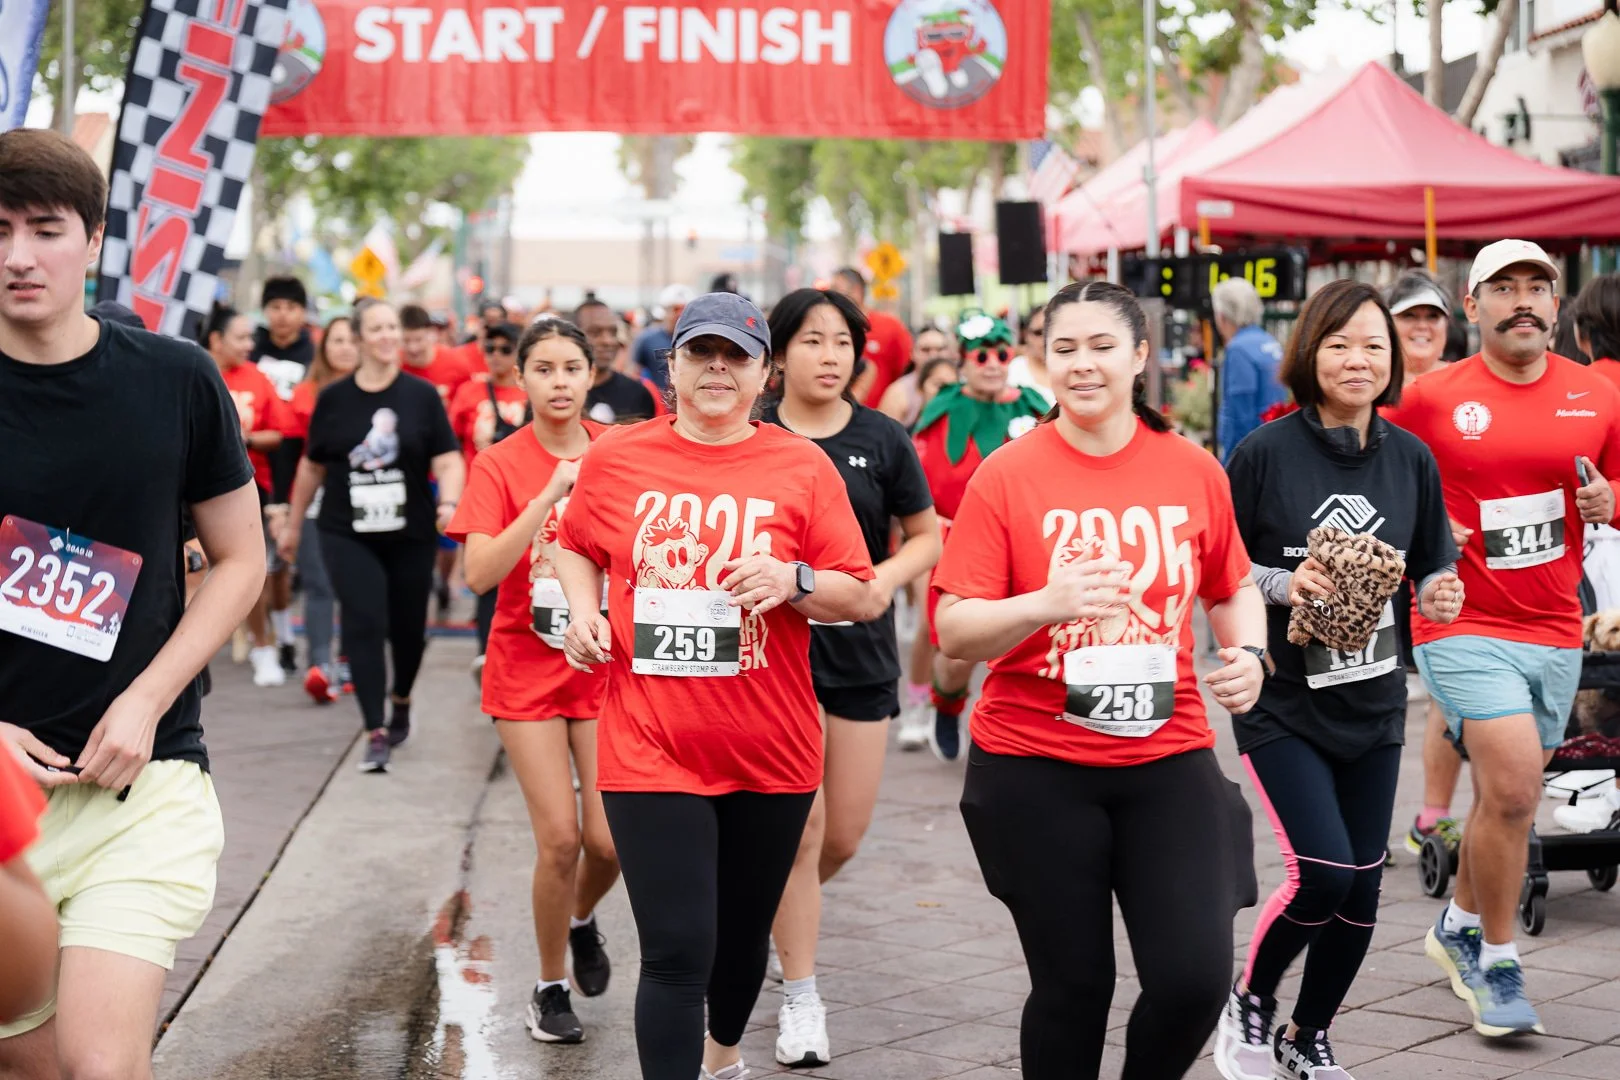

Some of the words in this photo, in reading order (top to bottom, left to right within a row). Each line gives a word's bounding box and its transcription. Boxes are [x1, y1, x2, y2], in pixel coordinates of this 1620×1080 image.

[354, 7, 564, 63] START
[576, 6, 607, 59] /
[623, 7, 851, 65] FINISH
[1502, 522, 1553, 556] 344
[1, 546, 115, 625] 2352
[653, 626, 716, 661] 259
[1089, 684, 1155, 720] 258
